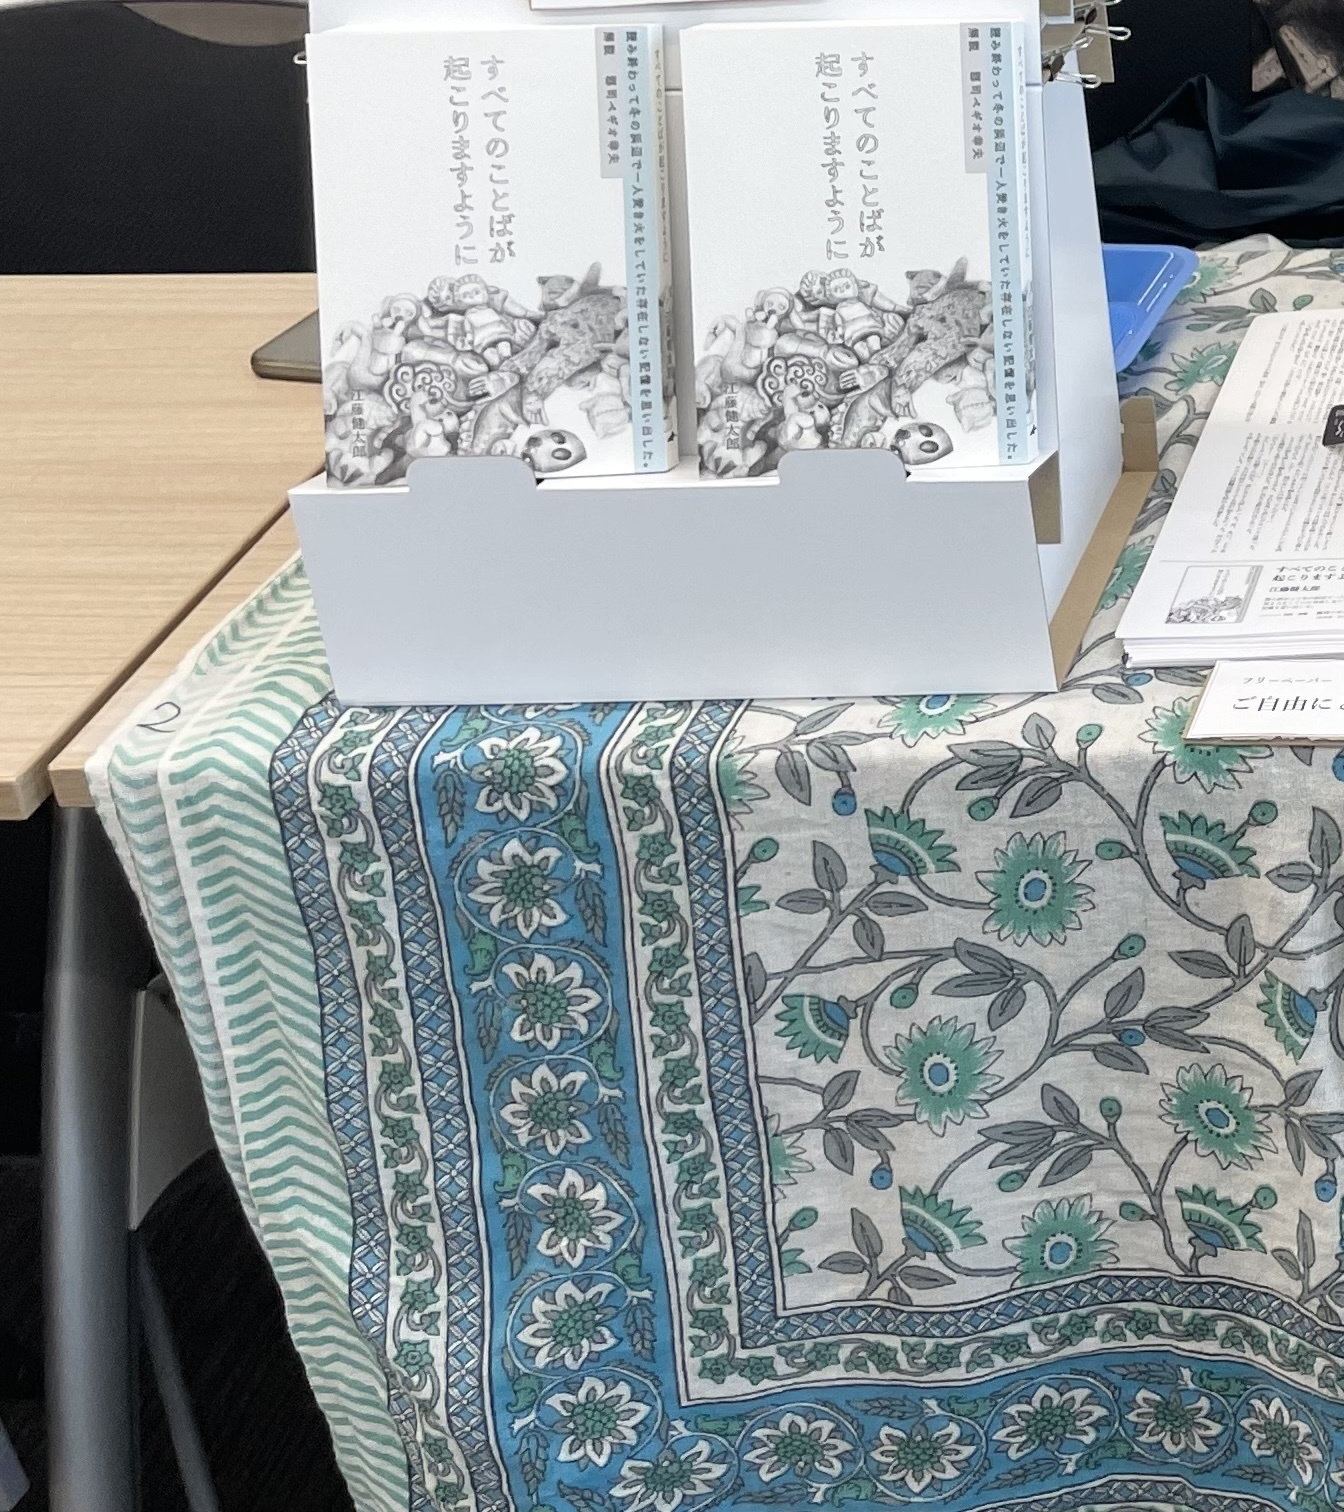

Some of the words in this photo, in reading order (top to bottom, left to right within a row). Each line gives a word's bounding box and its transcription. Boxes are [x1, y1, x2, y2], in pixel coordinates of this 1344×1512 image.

[443, 55, 479, 266] 起こりますように
[480, 54, 516, 264] すべてのことばが
[815, 52, 849, 261] 起こりますように
[851, 51, 885, 259] すべてのことばが
